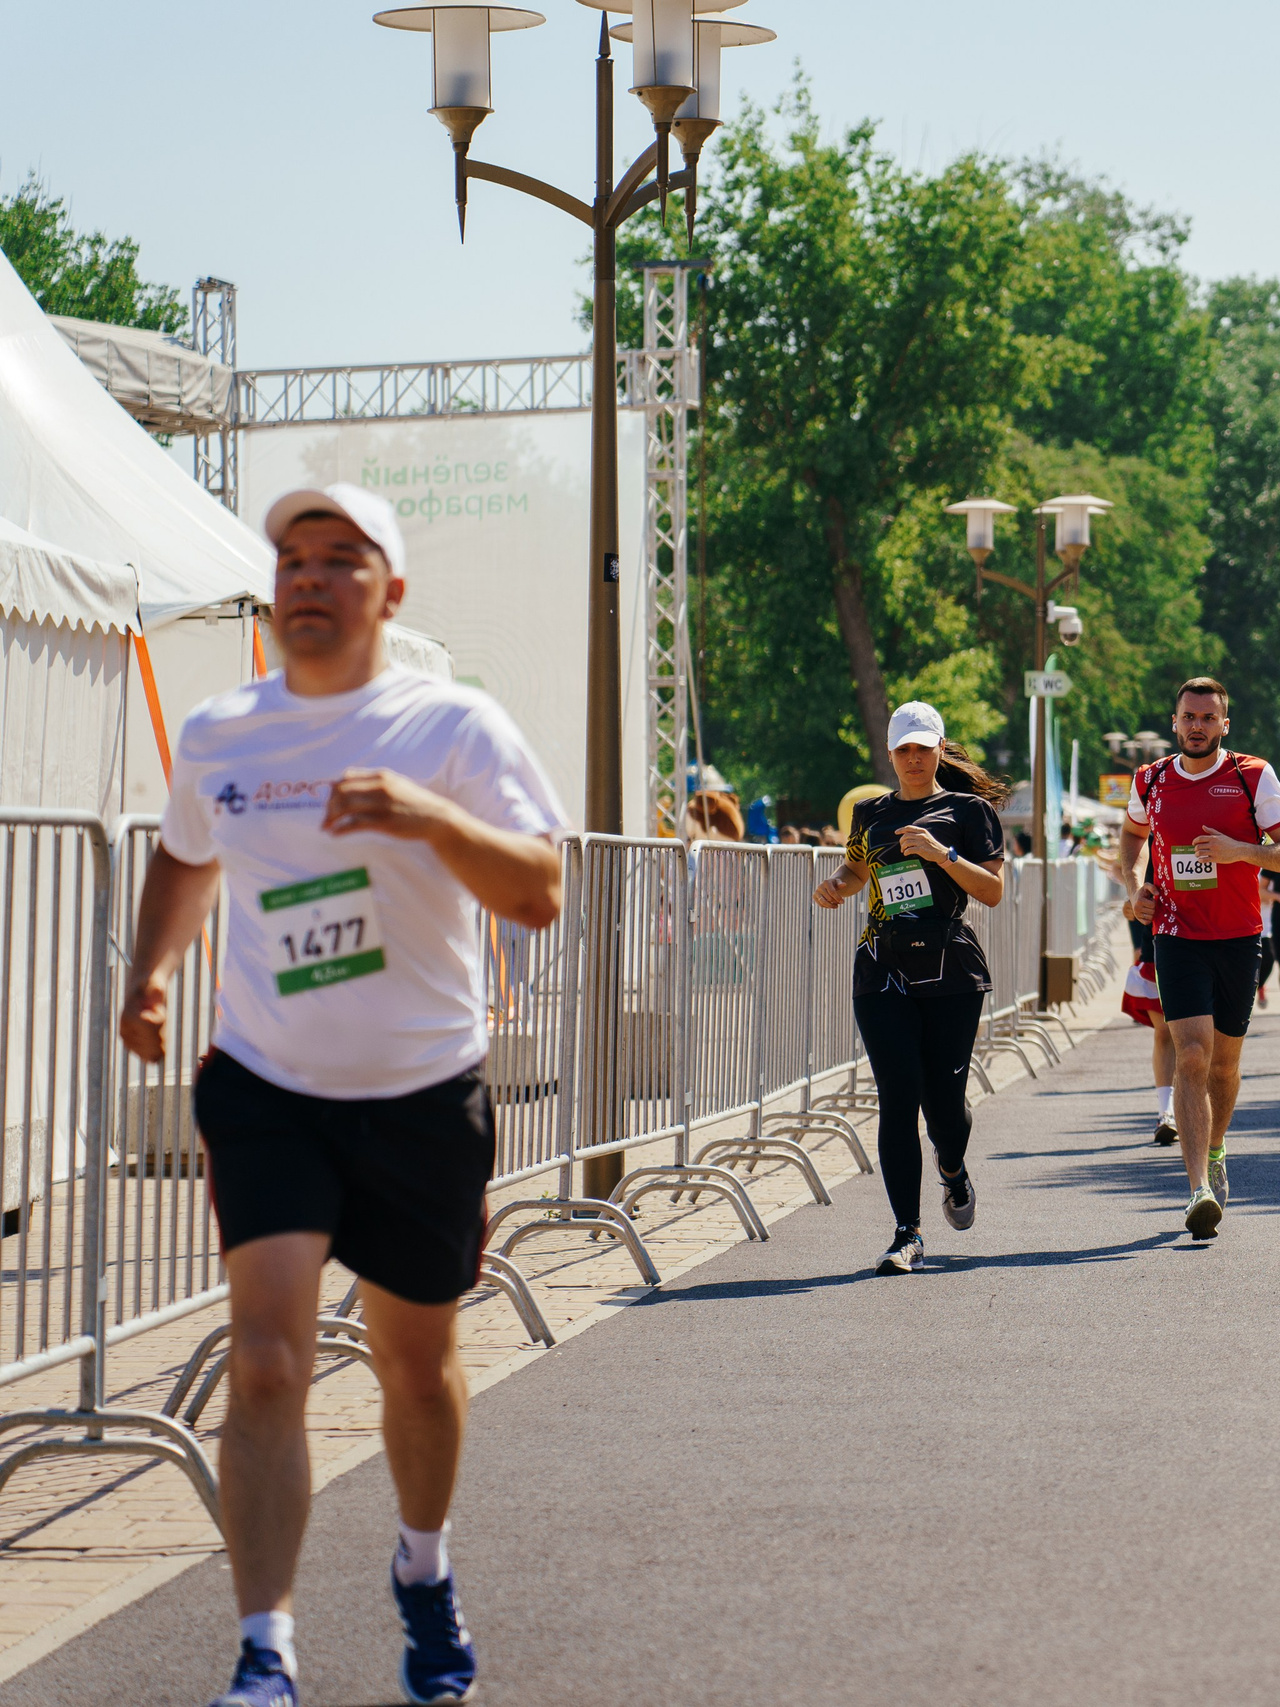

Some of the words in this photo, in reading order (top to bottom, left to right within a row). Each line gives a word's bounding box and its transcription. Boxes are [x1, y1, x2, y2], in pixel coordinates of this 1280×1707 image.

[1043, 678, 1062, 690] WC
[1176, 861, 1213, 874] 0488
[887, 881, 924, 902] 1301
[279, 916, 365, 963] 1477
